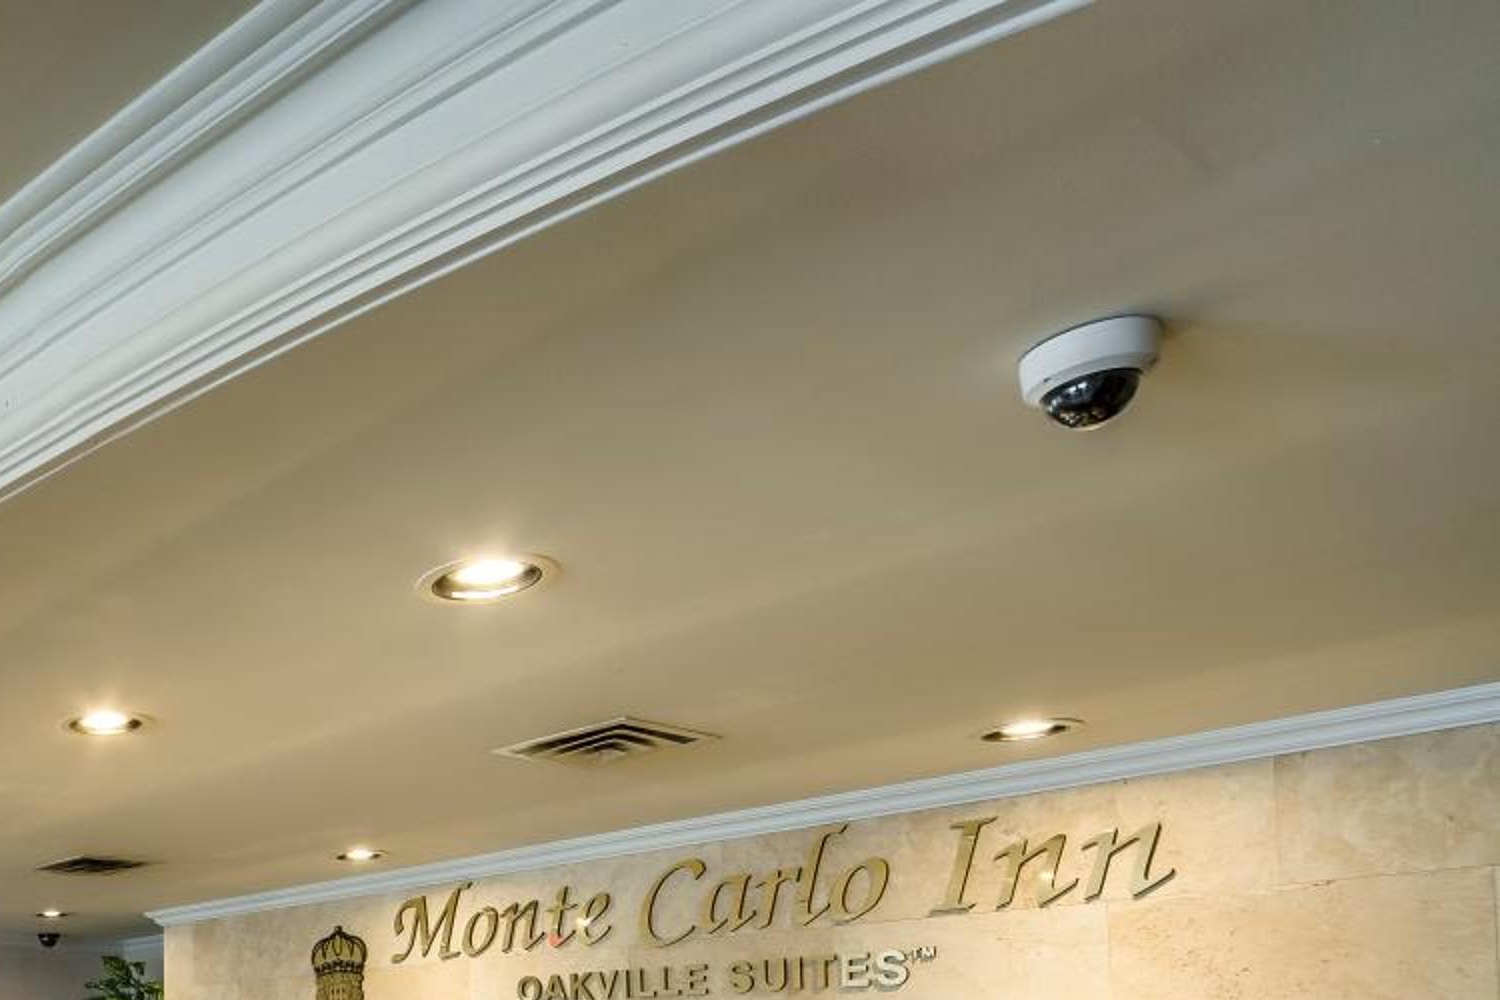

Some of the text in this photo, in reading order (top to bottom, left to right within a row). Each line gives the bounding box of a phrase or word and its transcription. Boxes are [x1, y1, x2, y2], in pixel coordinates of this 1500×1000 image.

[391, 816, 1176, 964] Monte Carlo Inn
